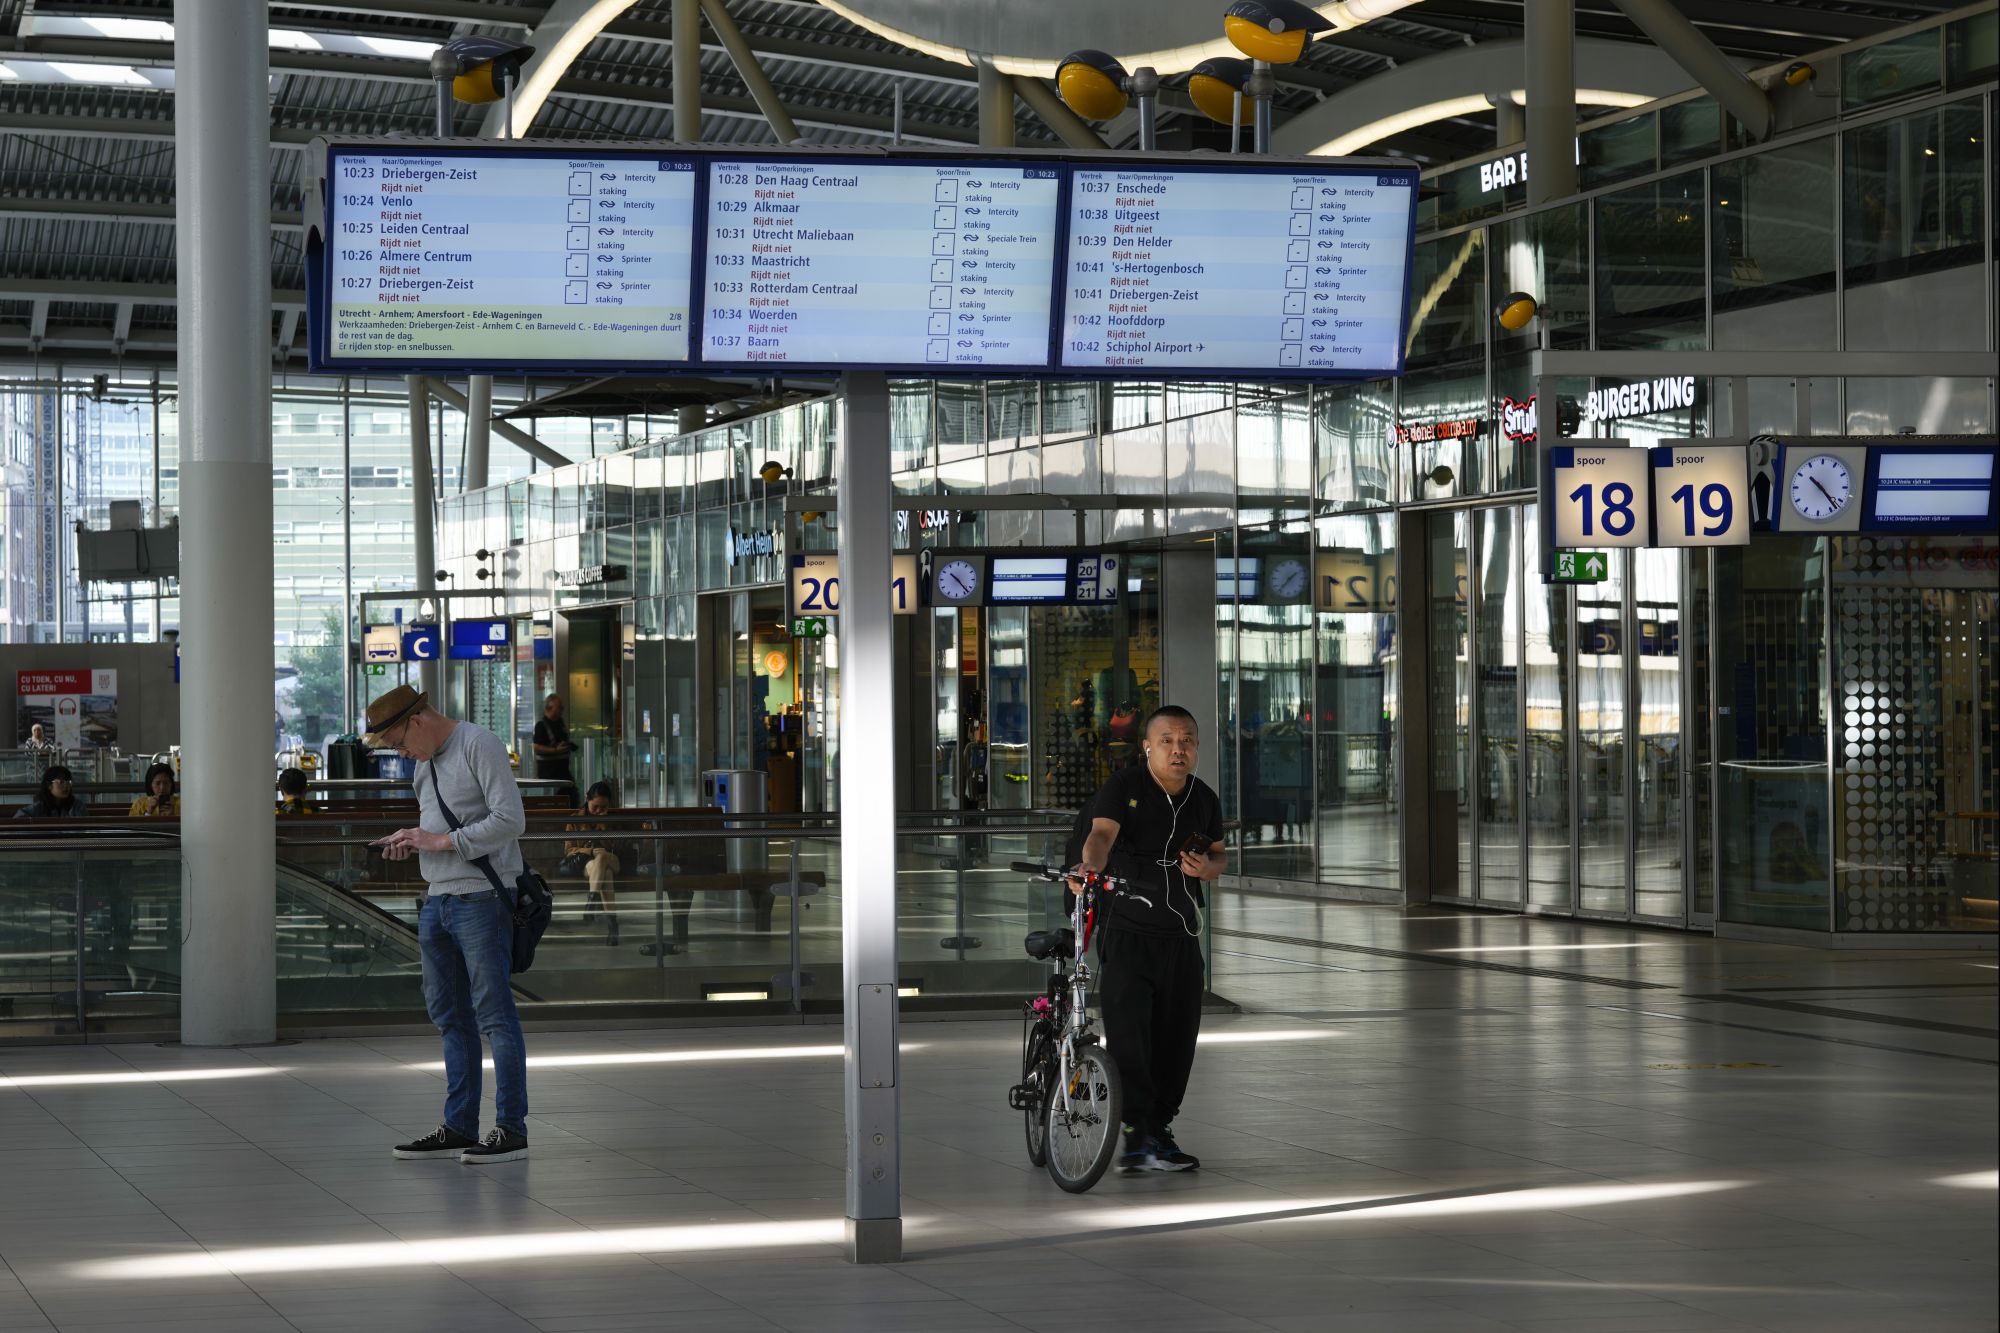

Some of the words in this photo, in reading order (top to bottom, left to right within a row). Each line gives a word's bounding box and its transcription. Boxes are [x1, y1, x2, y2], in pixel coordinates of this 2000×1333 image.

[382, 158, 442, 166] Naar/Opmerkingen
[569, 161, 605, 169] Spoor/Trein
[344, 167, 374, 178] 10:23
[382, 167, 477, 182] Driebergen-Zeist
[625, 173, 656, 184] Intercity
[1481, 156, 1516, 192] BAR
[718, 174, 749, 185] 10:28
[756, 175, 777, 185] Den
[780, 175, 809, 188] Haag
[812, 175, 858, 187] Centraal
[990, 181, 1021, 190] Intercity
[381, 183, 402, 194] Rijdt
[405, 184, 423, 192] niet
[600, 187, 627, 197] staking
[1081, 182, 1110, 193] 10:37
[1117, 182, 1167, 194] Enschede
[1344, 188, 1375, 198] Intercity
[343, 195, 374, 206] 10:24
[381, 195, 413, 207] Venlo
[623, 201, 655, 211] Intercity
[717, 201, 747, 212] 10:29
[754, 201, 800, 213] Alkmaar
[989, 208, 1019, 217] Intercity
[381, 211, 402, 222] Rijdt
[405, 211, 422, 220] niet
[1079, 209, 1108, 220] 10:38
[1115, 209, 1160, 222] Uitgeest
[1342, 215, 1371, 224] Sprinter
[342, 223, 373, 234] 10:25
[381, 223, 418, 234] Leiden
[422, 223, 469, 235] Centraal
[622, 228, 654, 238] Intercity
[716, 228, 745, 239] 10:31
[753, 228, 794, 240] Utrecht
[797, 229, 854, 241] Maliebaan
[380, 238, 401, 250] Rijdt
[404, 239, 421, 247] niet
[987, 234, 1017, 244] Speciale
[1019, 235, 1037, 243] Trein
[1077, 235, 1107, 246] 10:39
[1113, 236, 1134, 246] Den
[1137, 236, 1173, 247] Helder
[1340, 241, 1370, 251] Intercity
[342, 250, 373, 261] 10:26
[380, 250, 420, 261] Almere
[424, 251, 472, 262] Centrum
[621, 256, 652, 265] Sprinter
[714, 255, 744, 266] 10:33
[752, 255, 810, 267] Maastricht
[379, 265, 400, 277] Rijdt
[403, 266, 421, 275] niet
[985, 261, 1016, 270] Intercity
[1076, 262, 1104, 273] 10:41
[1112, 262, 1204, 276] 's-Hertogenbosch
[1338, 267, 1367, 276] Sprinter
[341, 277, 371, 288] 10:27
[379, 277, 474, 291] Driebergen-Zeist
[621, 282, 651, 291] Sprinter
[713, 282, 743, 293] 10:33
[750, 282, 808, 294] Rotterdam
[812, 283, 858, 294] Centraal
[984, 288, 1014, 297] Intercity
[1074, 289, 1102, 299] 10:41
[1110, 289, 1199, 302] Driebergen-Zeist
[379, 293, 400, 304] Rijdt
[402, 293, 420, 302] niet
[1336, 294, 1366, 303] Intercity
[339, 309, 371, 318] Utrecht
[379, 310, 414, 319] Arnhem;
[417, 310, 465, 319] Amersfoort
[473, 311, 542, 321] Ede-Wageningen
[670, 313, 682, 321] 2/8
[712, 309, 742, 319] 10:34
[749, 309, 798, 320] Woerden
[982, 314, 1012, 324] Sprinter
[338, 320, 407, 329] Werkzaamheden:
[409, 320, 475, 331] Driebergen-Zeist
[482, 321, 513, 330] Arnhem
[537, 322, 576, 330] Barneveld
[578, 323, 585, 331] C.
[593, 322, 658, 333] Ede-Wageningen
[661, 323, 682, 331] duurt
[1073, 315, 1101, 326] 10:42
[1108, 314, 1165, 328] Hoofddorp
[1334, 320, 1363, 329] Sprinter
[339, 331, 349, 339] de
[385, 332, 395, 340] de
[397, 332, 414, 341] dag.
[711, 336, 740, 346] 10:37
[748, 336, 779, 347] Baarn
[349, 342, 372, 352] rijden
[374, 343, 394, 352] stop-
[409, 343, 454, 351] snelbussen.
[981, 341, 1010, 350] Sprinter
[1071, 341, 1100, 352] 10:42
[1106, 341, 1151, 354] Schiphol
[1154, 342, 1193, 355] Airport
[1332, 346, 1362, 355] Intercity
[1588, 382, 1650, 422] BURGER
[1653, 376, 1694, 411] KING
[1410, 422, 1435, 441] doner
[1437, 418, 1478, 440] company
[1576, 456, 1605, 467] spoor
[1676, 454, 1705, 466] spoor
[1569, 483, 1635, 536] 18
[1671, 483, 1733, 537] 19
[736, 533, 755, 556] Albert
[755, 530, 772, 558] Heijn
[806, 560, 825, 568] spoor
[585, 566, 602, 583] COFFEE
[800, 577, 839, 610] 20
[414, 637, 430, 657] C
[54, 675, 62, 683] CU
